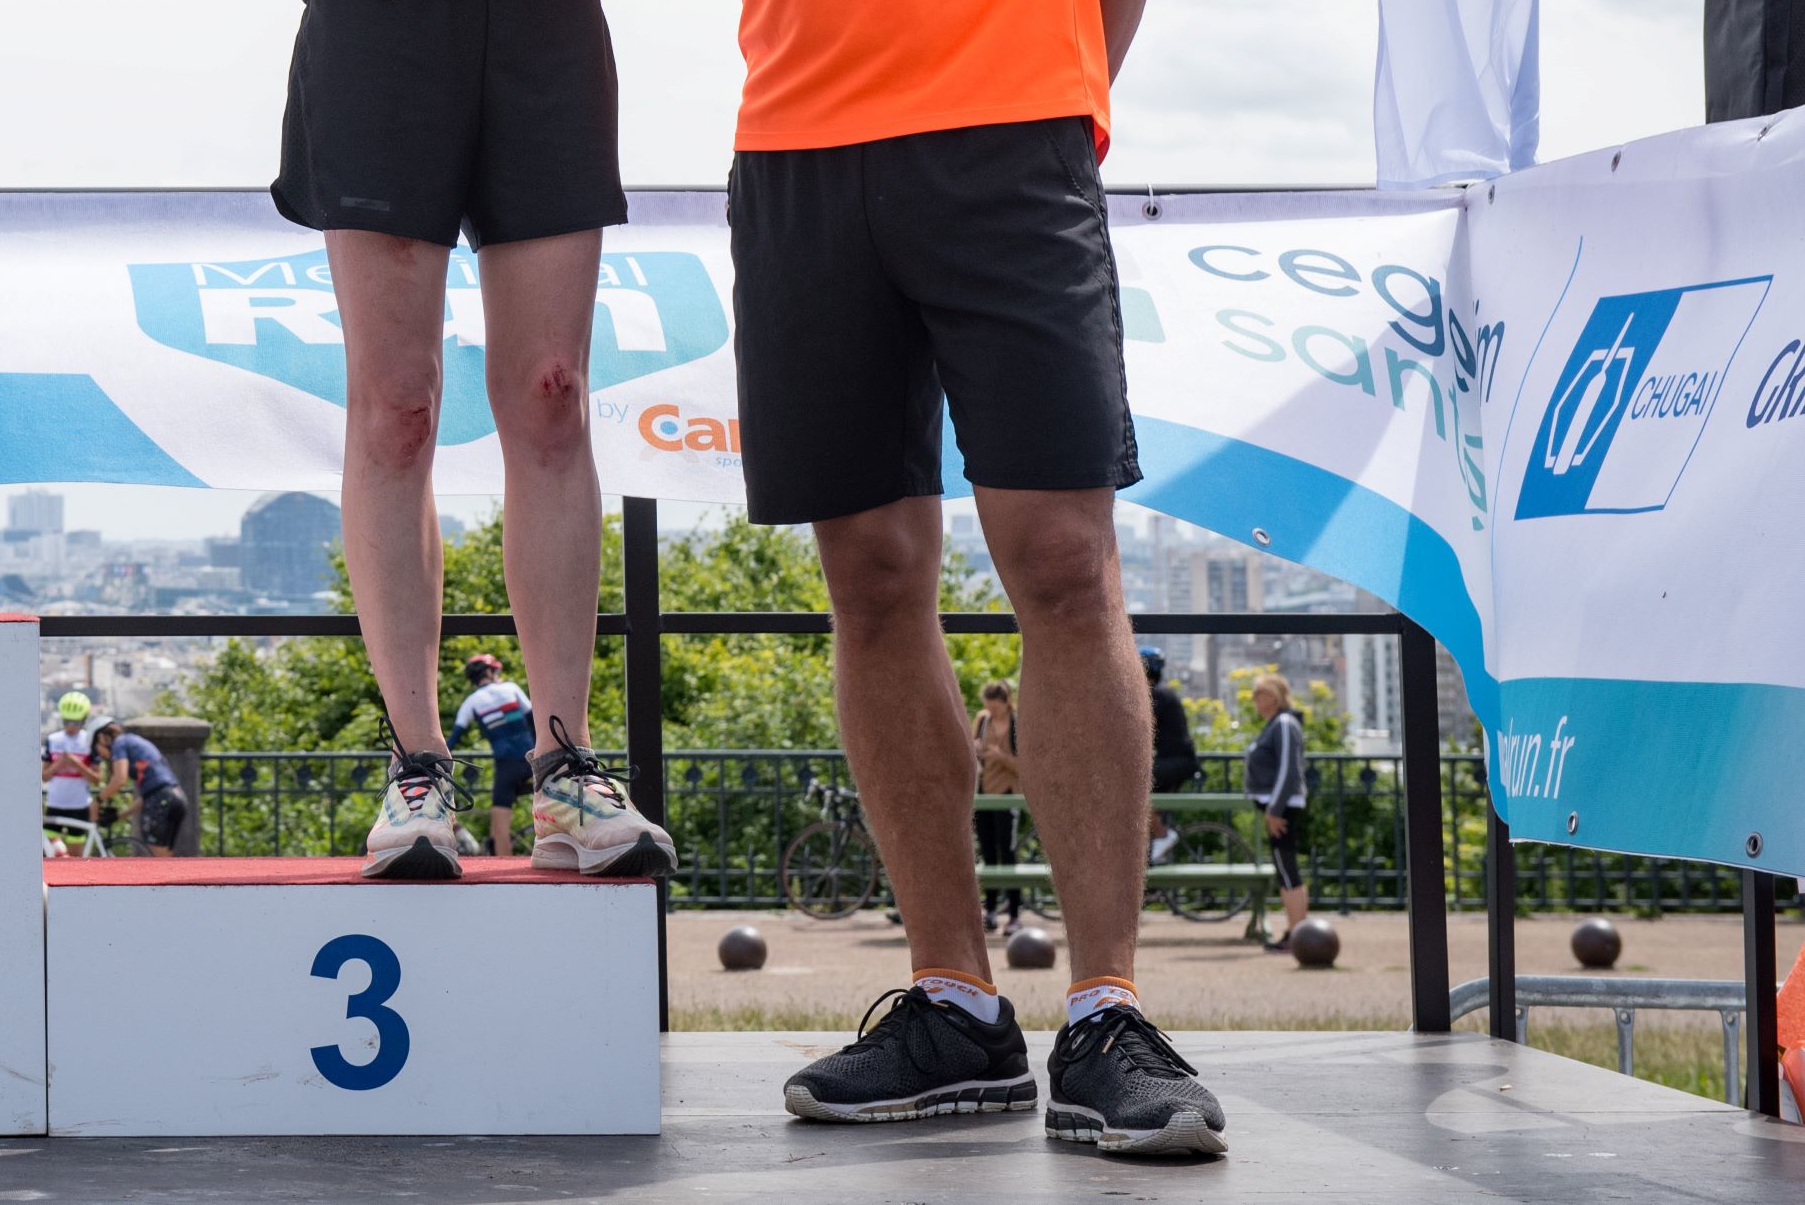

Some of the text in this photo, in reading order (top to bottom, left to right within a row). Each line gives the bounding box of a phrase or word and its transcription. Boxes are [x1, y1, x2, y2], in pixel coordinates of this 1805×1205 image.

[197, 287, 668, 353] Rn
[597, 398, 629, 424] by
[1631, 370, 1718, 420] CHUGAI
[310, 933, 411, 1092] 3
